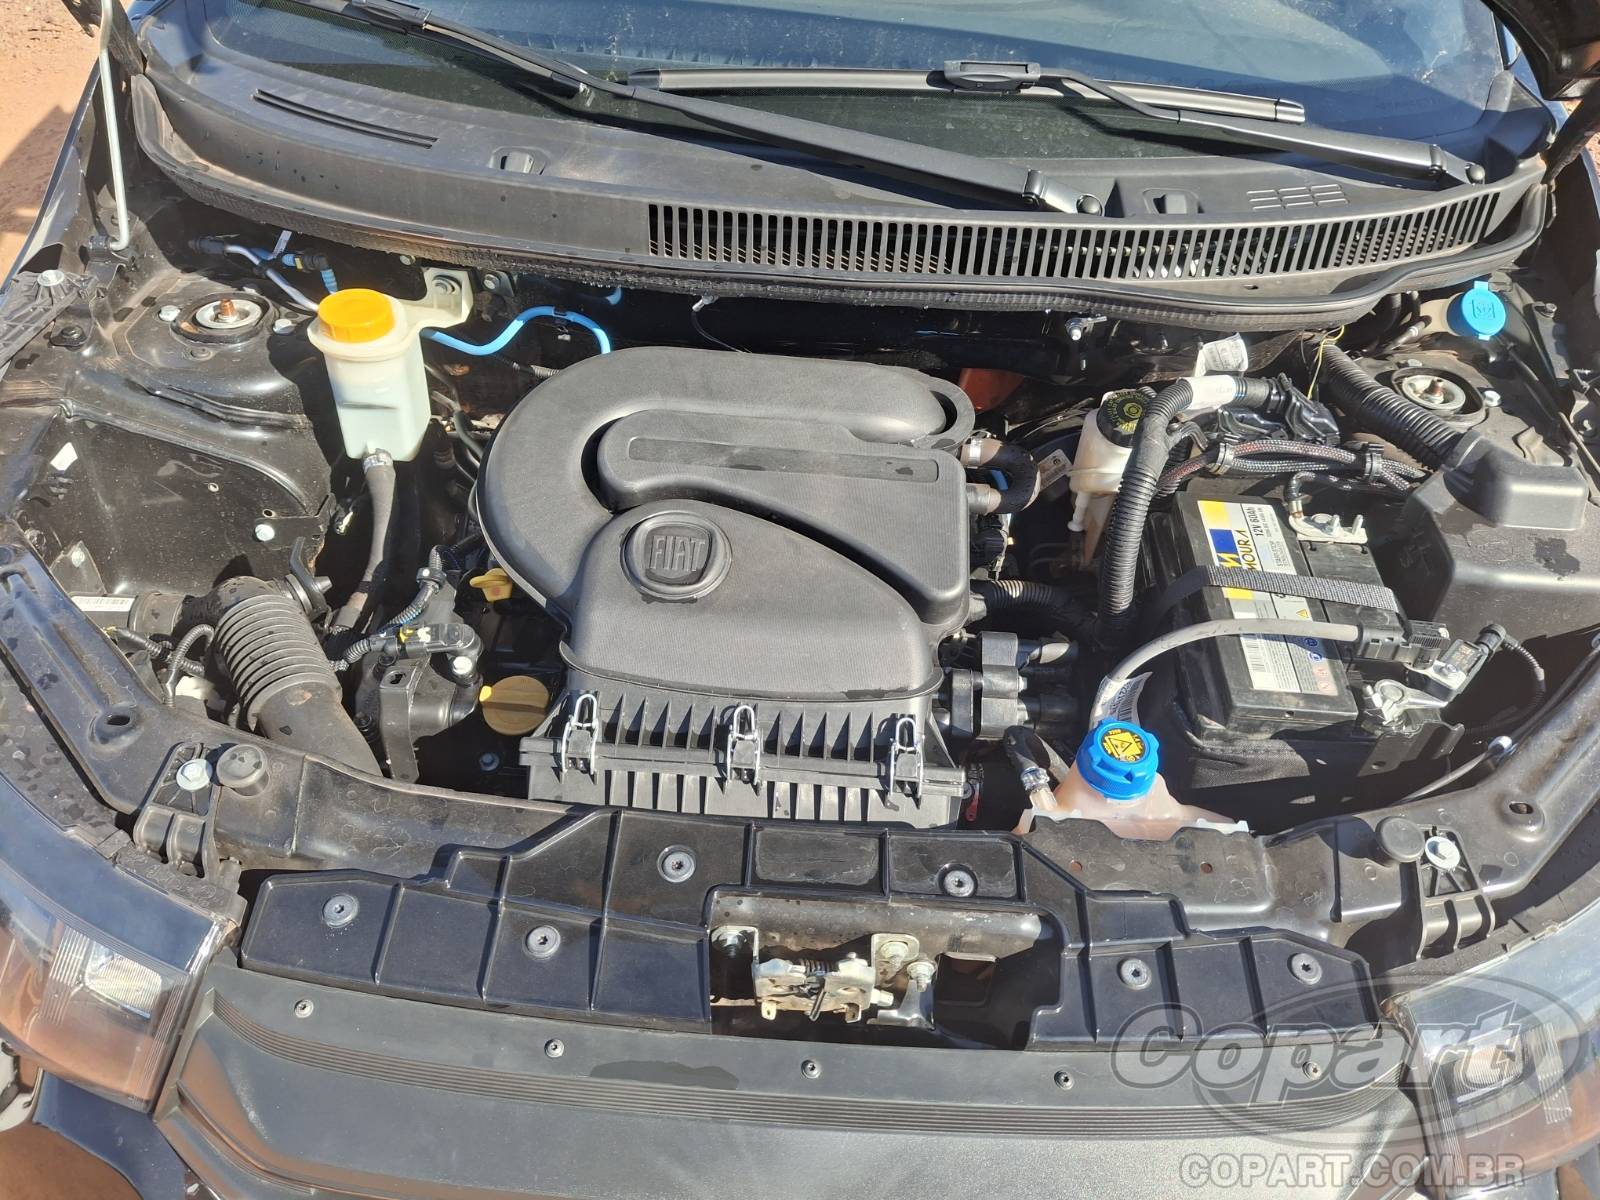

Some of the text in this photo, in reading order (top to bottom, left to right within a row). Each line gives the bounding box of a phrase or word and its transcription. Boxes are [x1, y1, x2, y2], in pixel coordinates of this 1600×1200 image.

[1252, 525, 1264, 536] 12V
[650, 535, 706, 572] FIAT
[1237, 530, 1256, 570] MOURA
